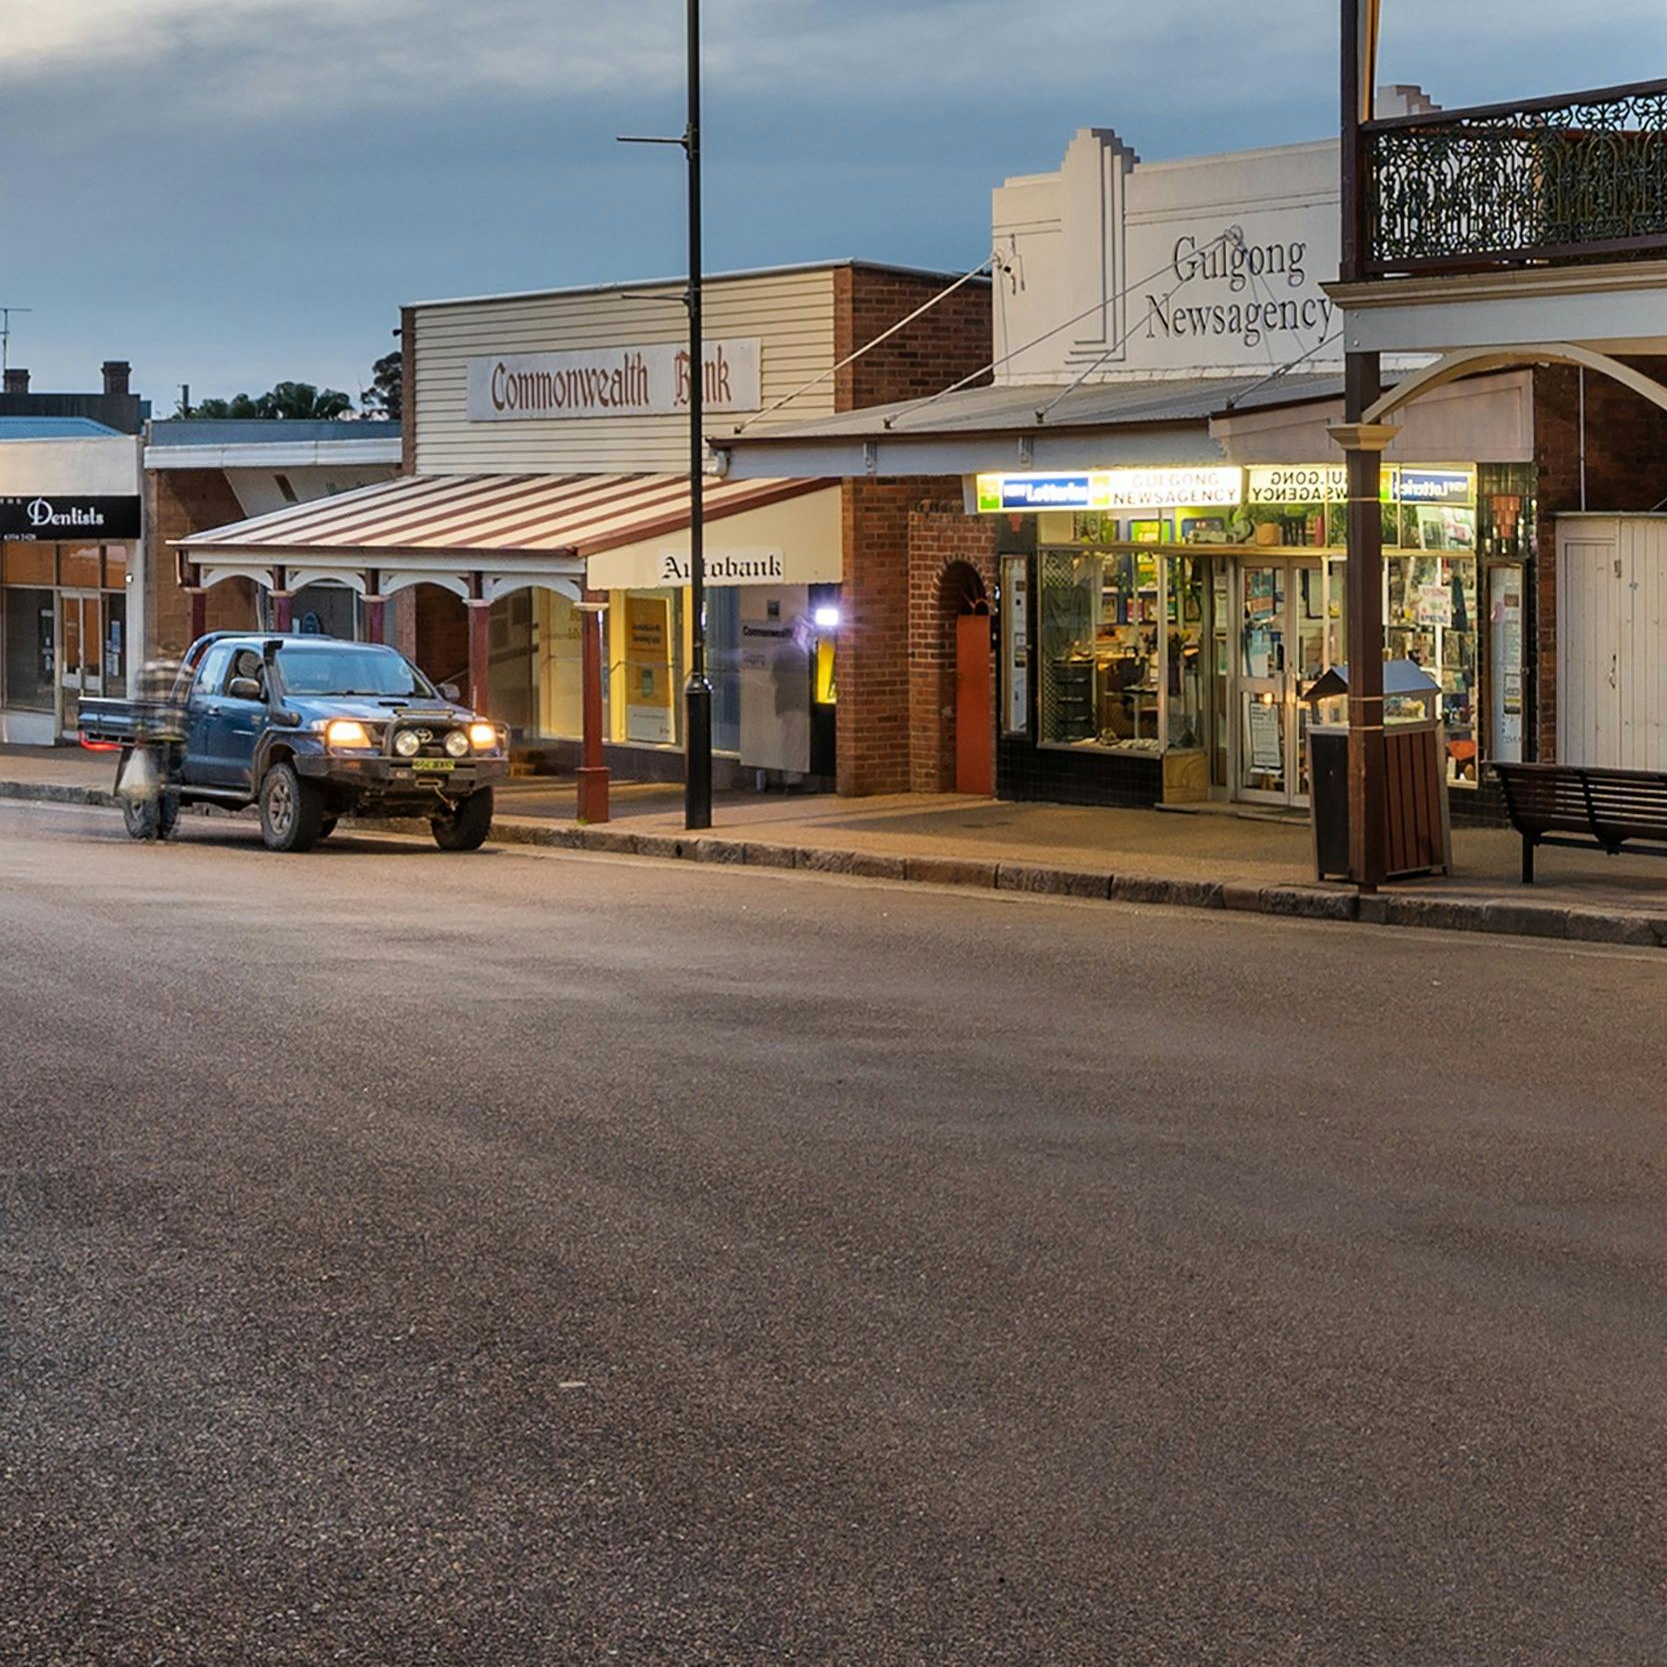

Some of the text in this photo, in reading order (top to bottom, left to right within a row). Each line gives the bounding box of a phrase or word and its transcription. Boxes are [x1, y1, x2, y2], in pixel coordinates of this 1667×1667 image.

[1174, 236, 1307, 292] Gulgong
[1145, 291, 1334, 348] Newsagency
[491, 344, 732, 411] Commonwealth Bnk
[27, 497, 105, 526] Dentists
[1113, 487, 1237, 505] NEWSAGENCY
